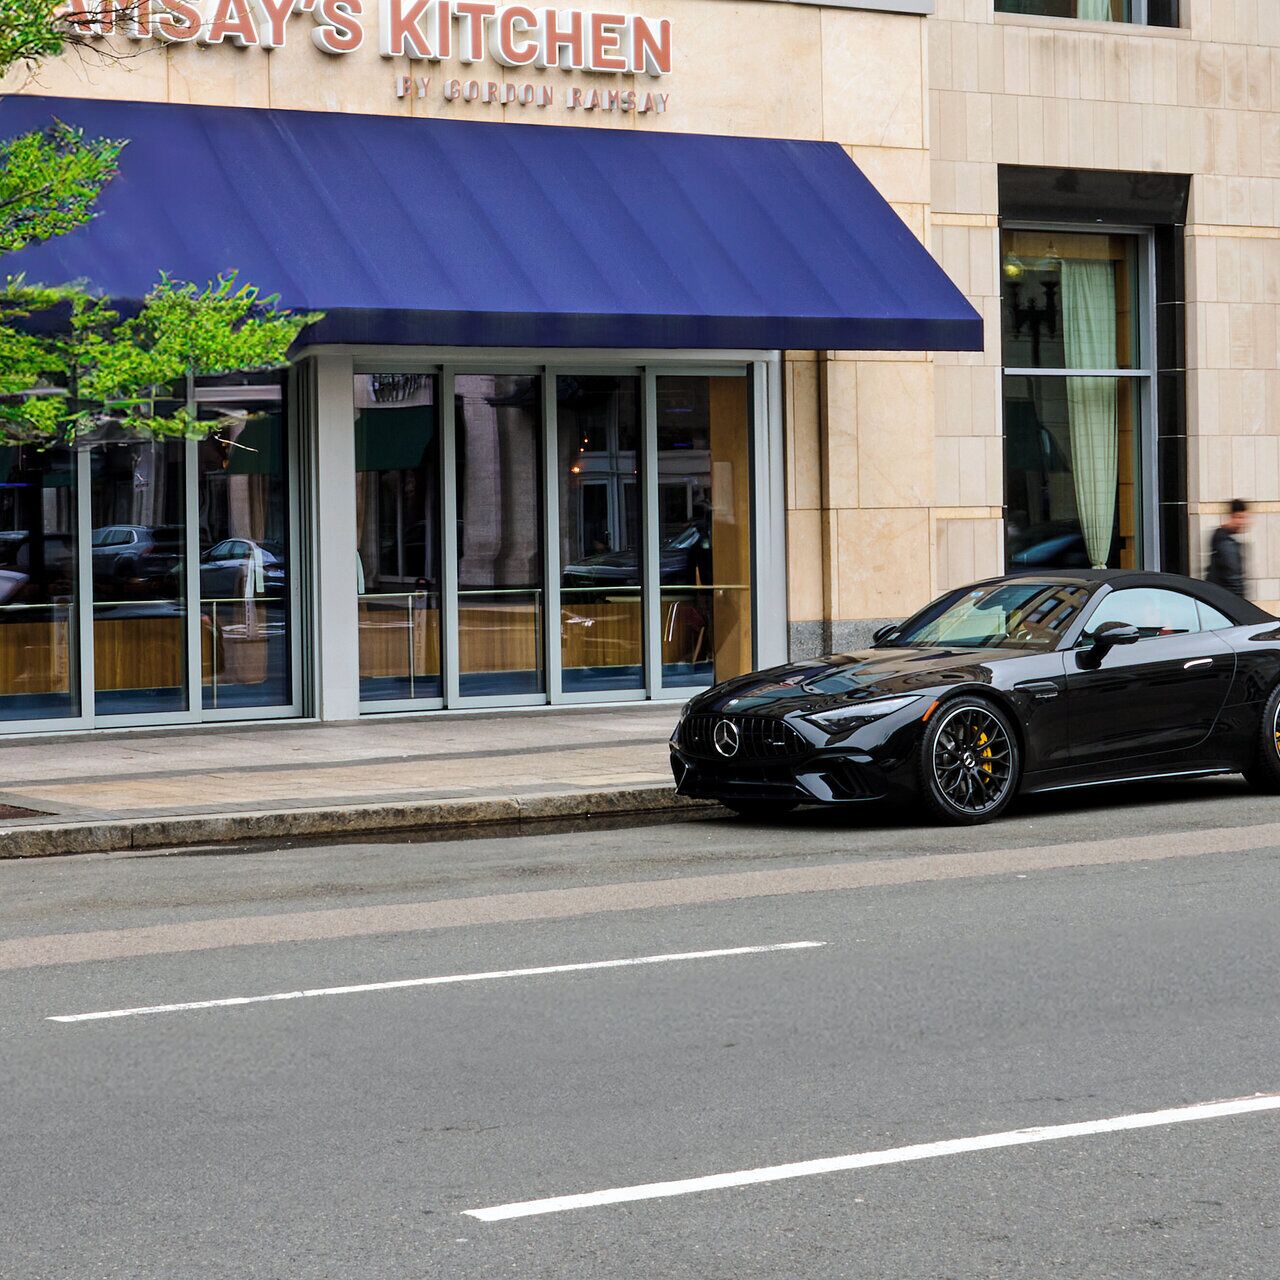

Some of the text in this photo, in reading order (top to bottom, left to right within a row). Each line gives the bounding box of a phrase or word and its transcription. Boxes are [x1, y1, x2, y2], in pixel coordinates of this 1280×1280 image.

[397, 75, 669, 113] BY GORDON RAMSAY
